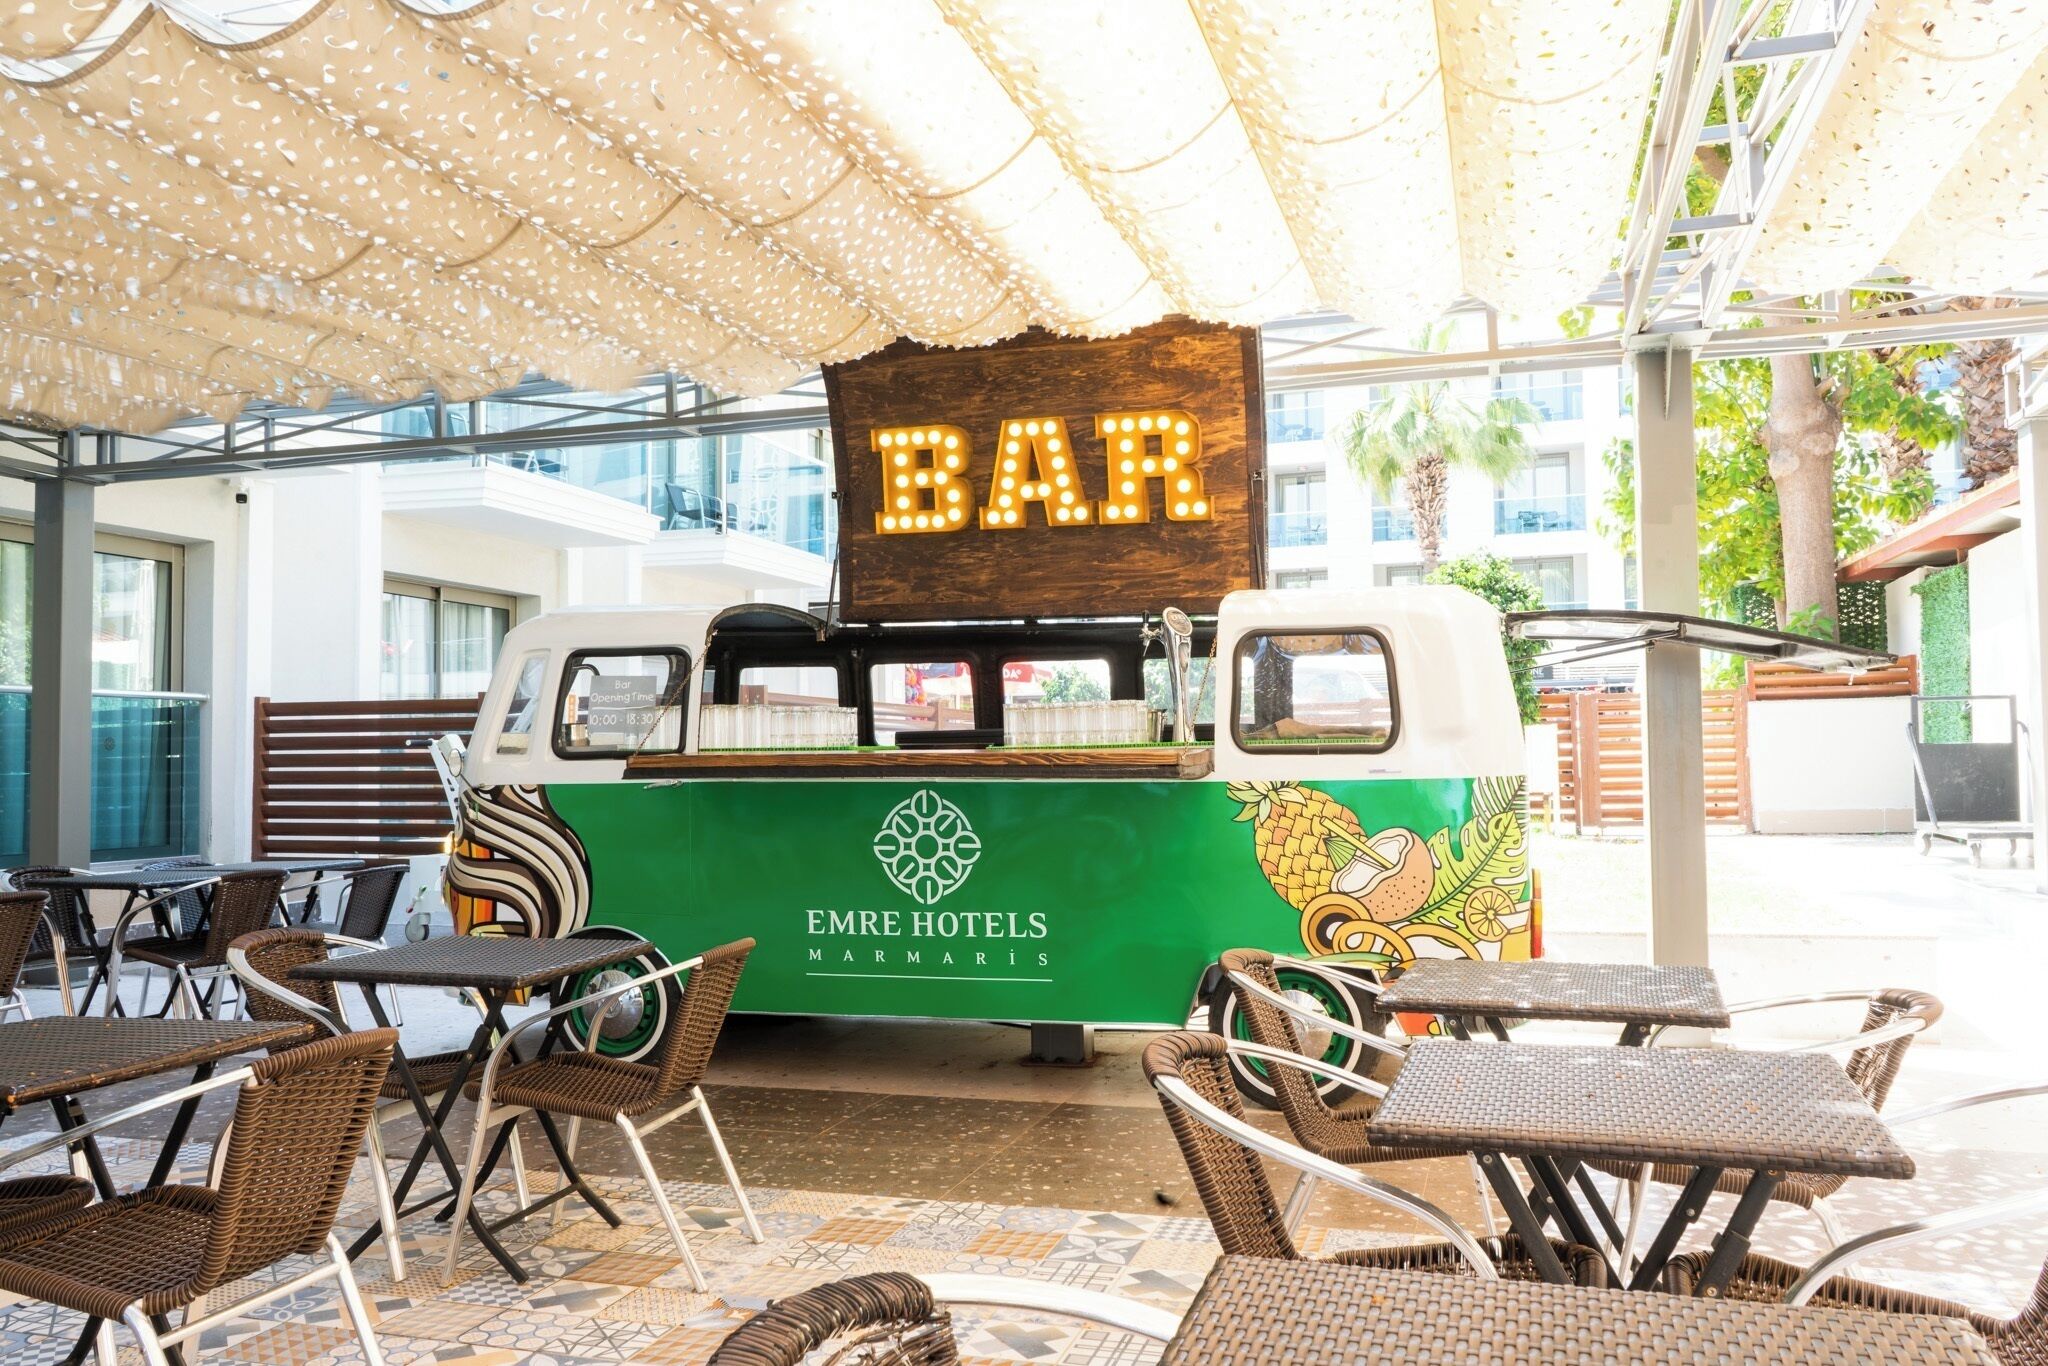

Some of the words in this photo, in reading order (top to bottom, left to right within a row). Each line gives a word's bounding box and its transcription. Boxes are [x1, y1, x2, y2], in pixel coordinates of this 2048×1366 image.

[871, 409, 1215, 534] BAR
[615, 680, 632, 690] Bar
[590, 692, 631, 704] Opening
[632, 692, 654, 702] Time
[589, 714, 617, 726] 10:00
[626, 712, 654, 725] 18:30
[806, 909, 902, 936] EMRE
[911, 911, 1048, 938] HOTELS
